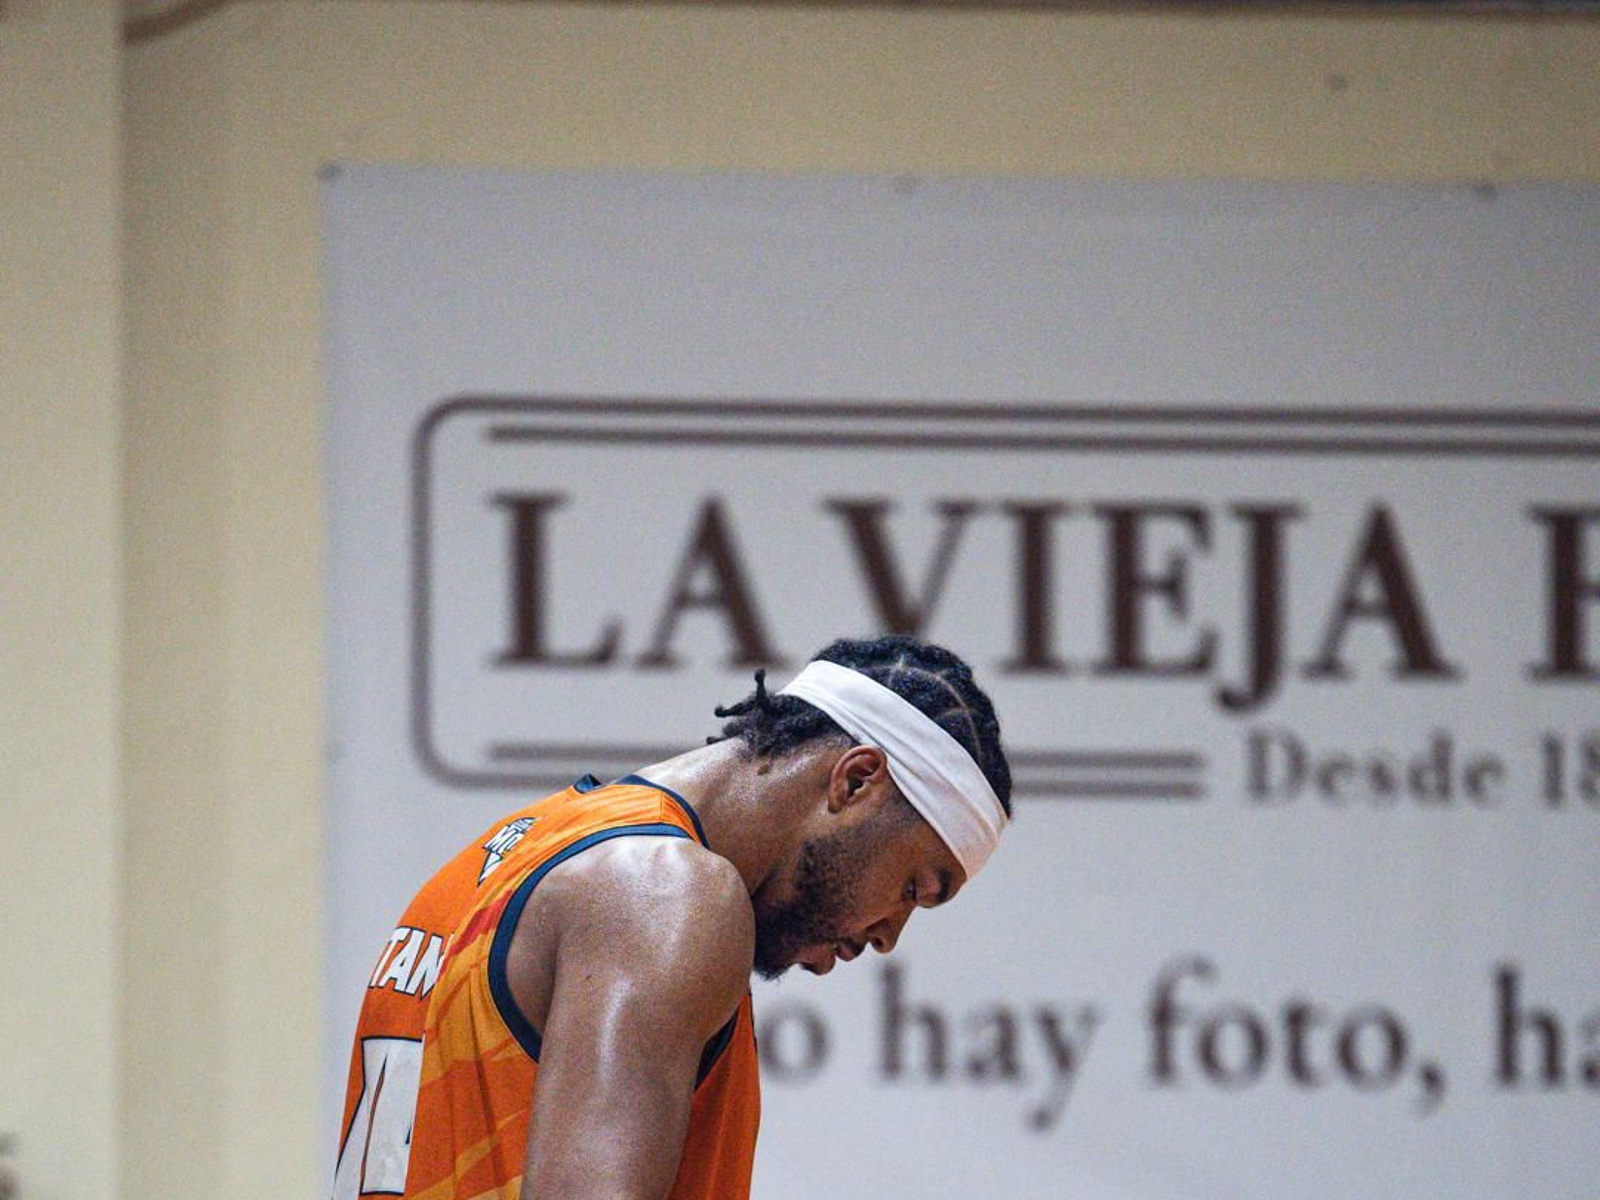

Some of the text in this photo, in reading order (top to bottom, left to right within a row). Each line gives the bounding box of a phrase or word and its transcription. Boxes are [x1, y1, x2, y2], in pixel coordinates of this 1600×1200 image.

[490, 488, 796, 670] LA
[820, 496, 1466, 715] VIEJA
[1246, 727, 1506, 806] Desde
[755, 1002, 831, 1087] o
[874, 957, 1100, 1134] hay
[1145, 954, 1447, 1116] foto,
